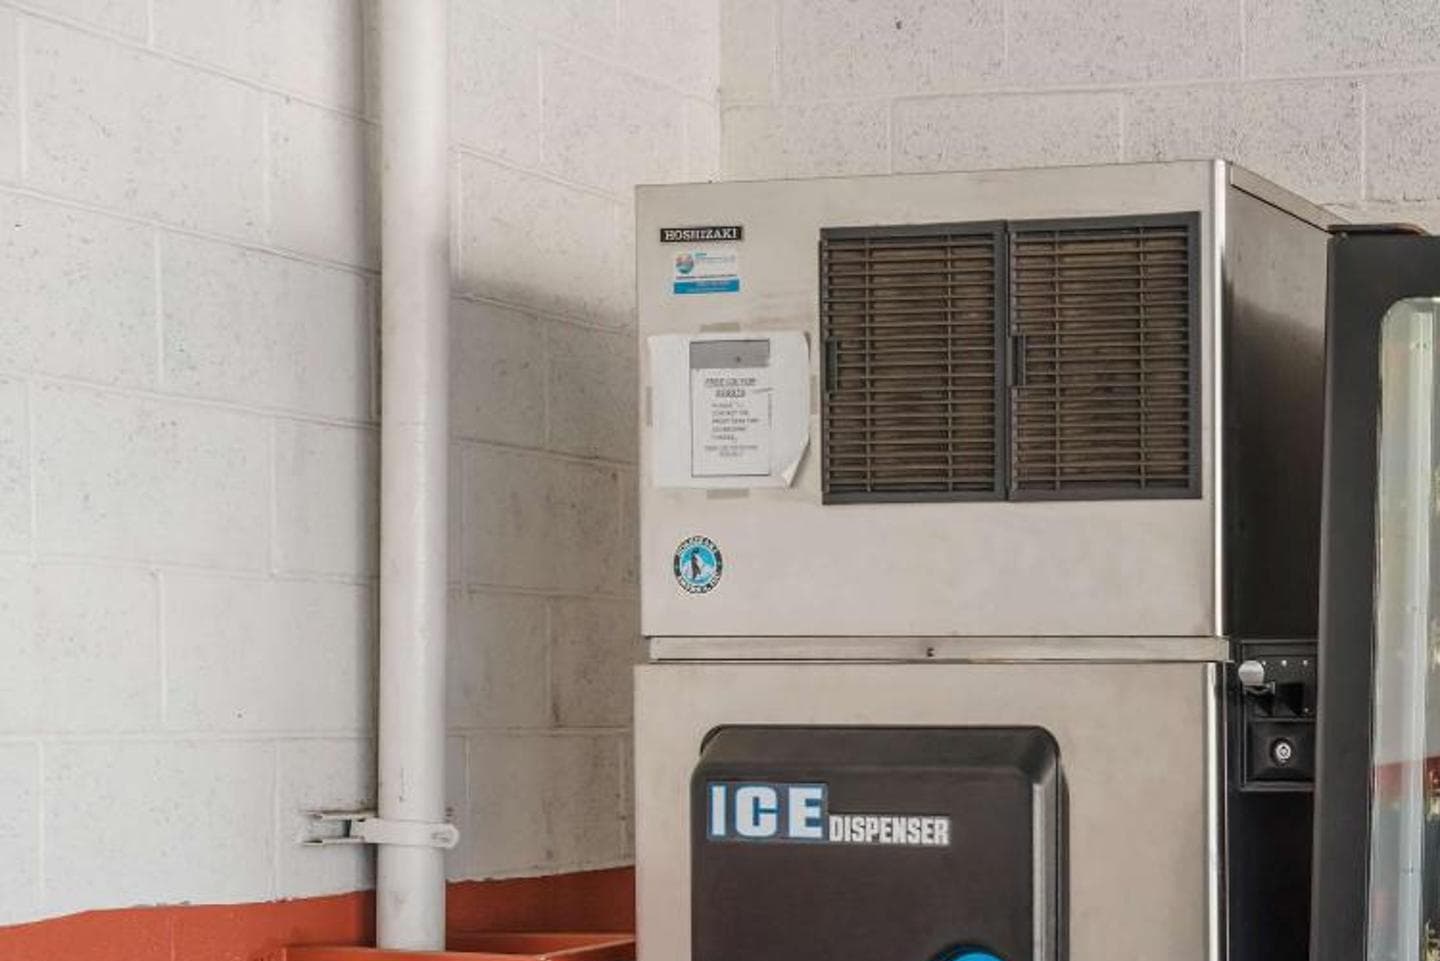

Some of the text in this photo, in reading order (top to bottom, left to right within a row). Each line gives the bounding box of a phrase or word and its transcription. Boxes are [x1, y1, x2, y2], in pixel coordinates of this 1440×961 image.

[664, 227, 738, 241] HOSHIZAKI
[708, 784, 952, 846] ICE DISPENSER
